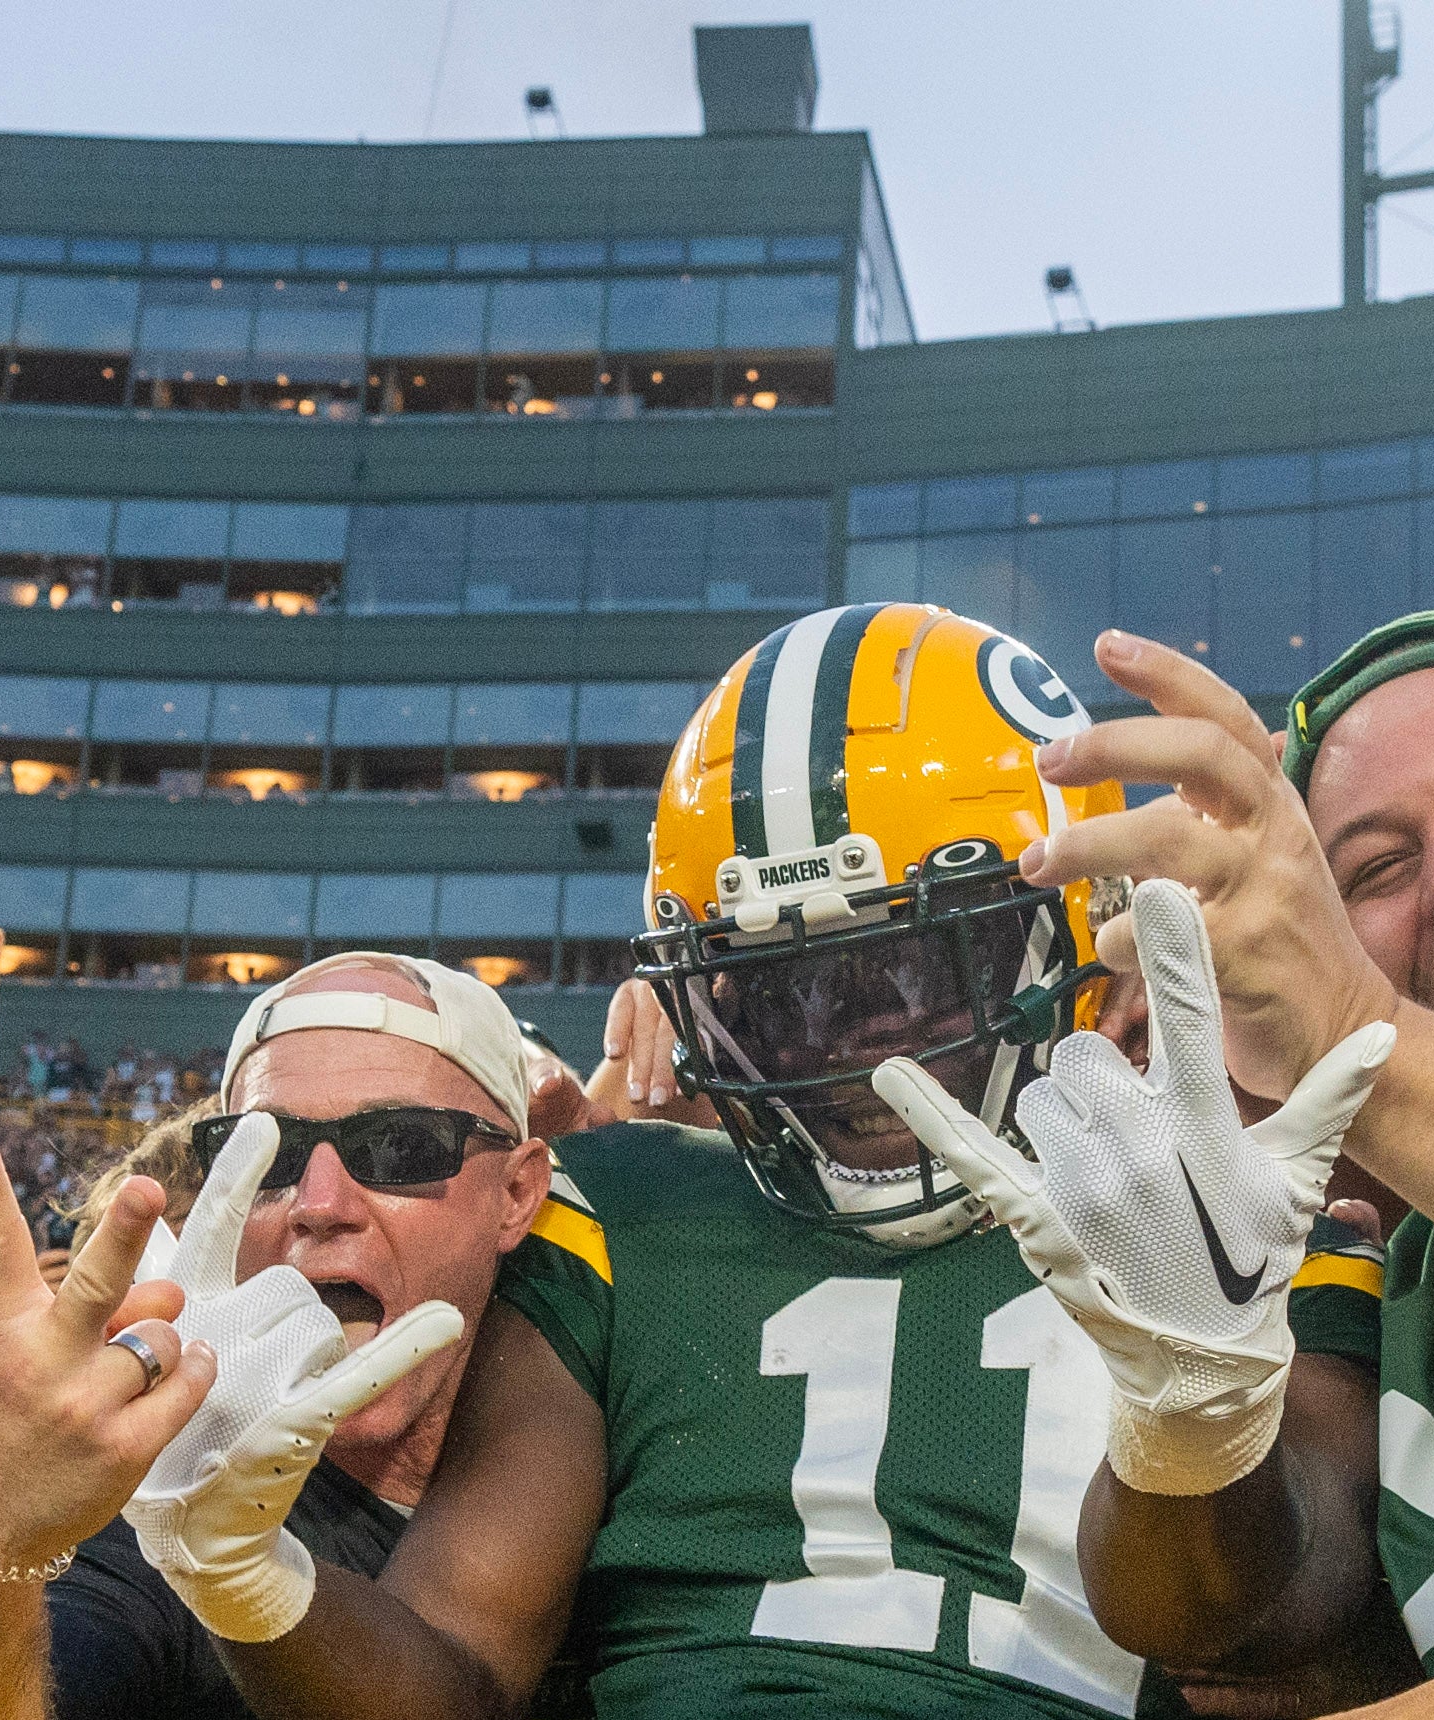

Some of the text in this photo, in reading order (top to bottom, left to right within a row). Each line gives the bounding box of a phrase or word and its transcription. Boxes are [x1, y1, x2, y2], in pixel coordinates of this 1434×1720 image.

[987, 641, 1092, 739] G
[758, 857, 831, 889] PACKERS
[750, 1277, 1147, 1720] 11
